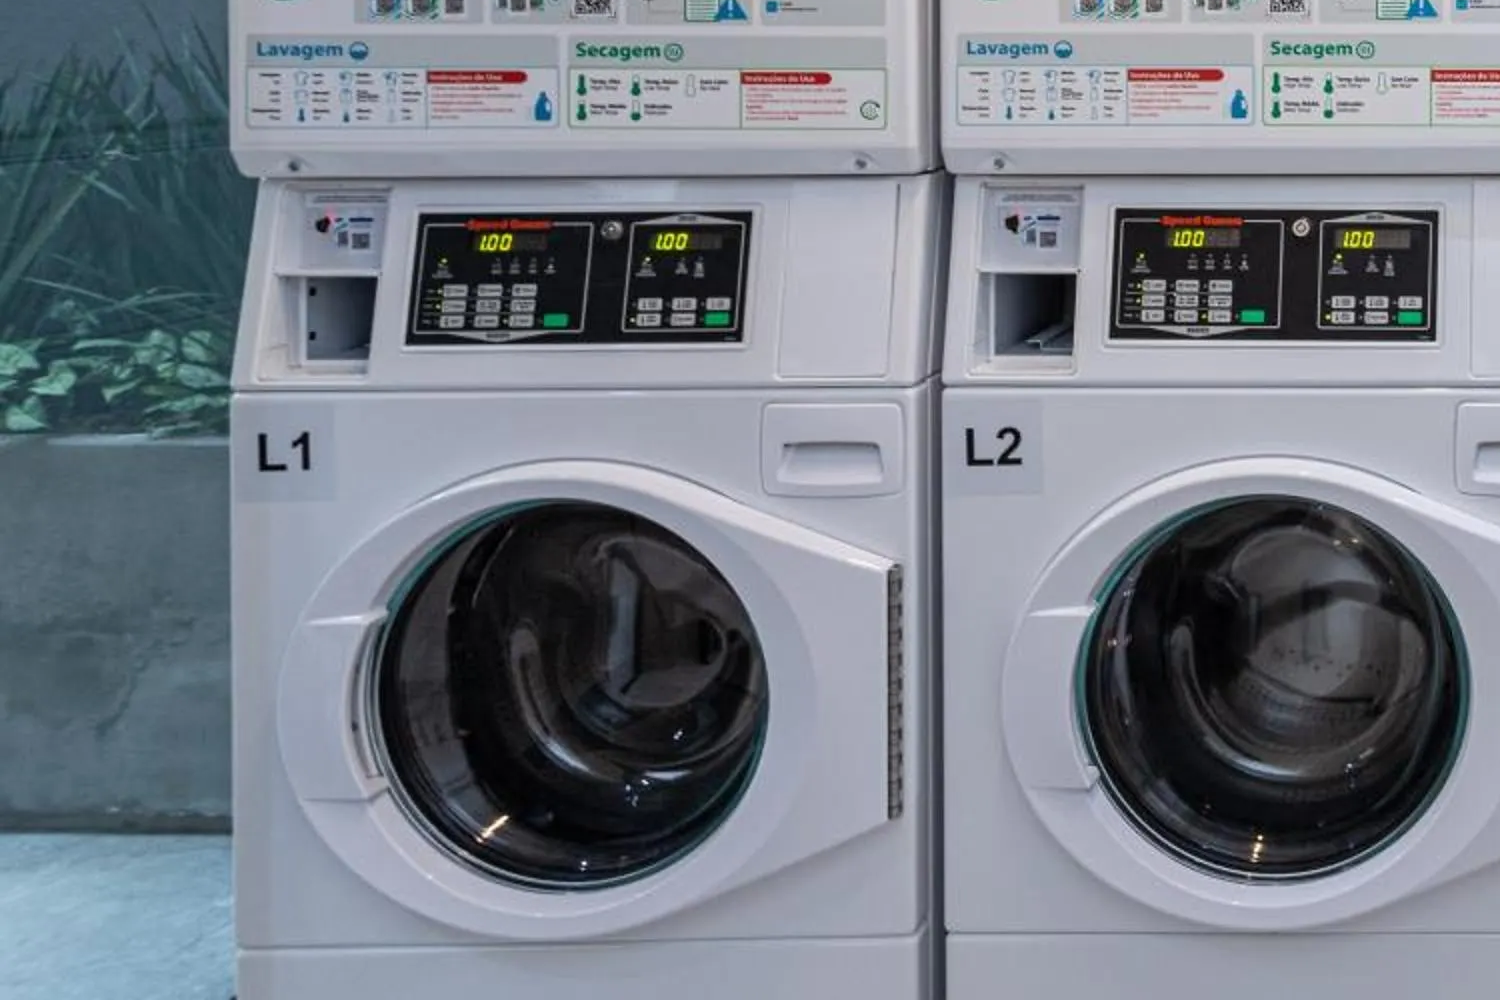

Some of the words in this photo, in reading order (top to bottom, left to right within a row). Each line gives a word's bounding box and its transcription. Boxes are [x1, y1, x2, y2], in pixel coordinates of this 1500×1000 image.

[257, 41, 343, 61] Lavagem
[576, 42, 661, 62] Secagem
[967, 40, 1048, 59] Lavagem
[1271, 41, 1352, 59] Secagem
[257, 431, 311, 472] L1
[965, 427, 1024, 467] L2
